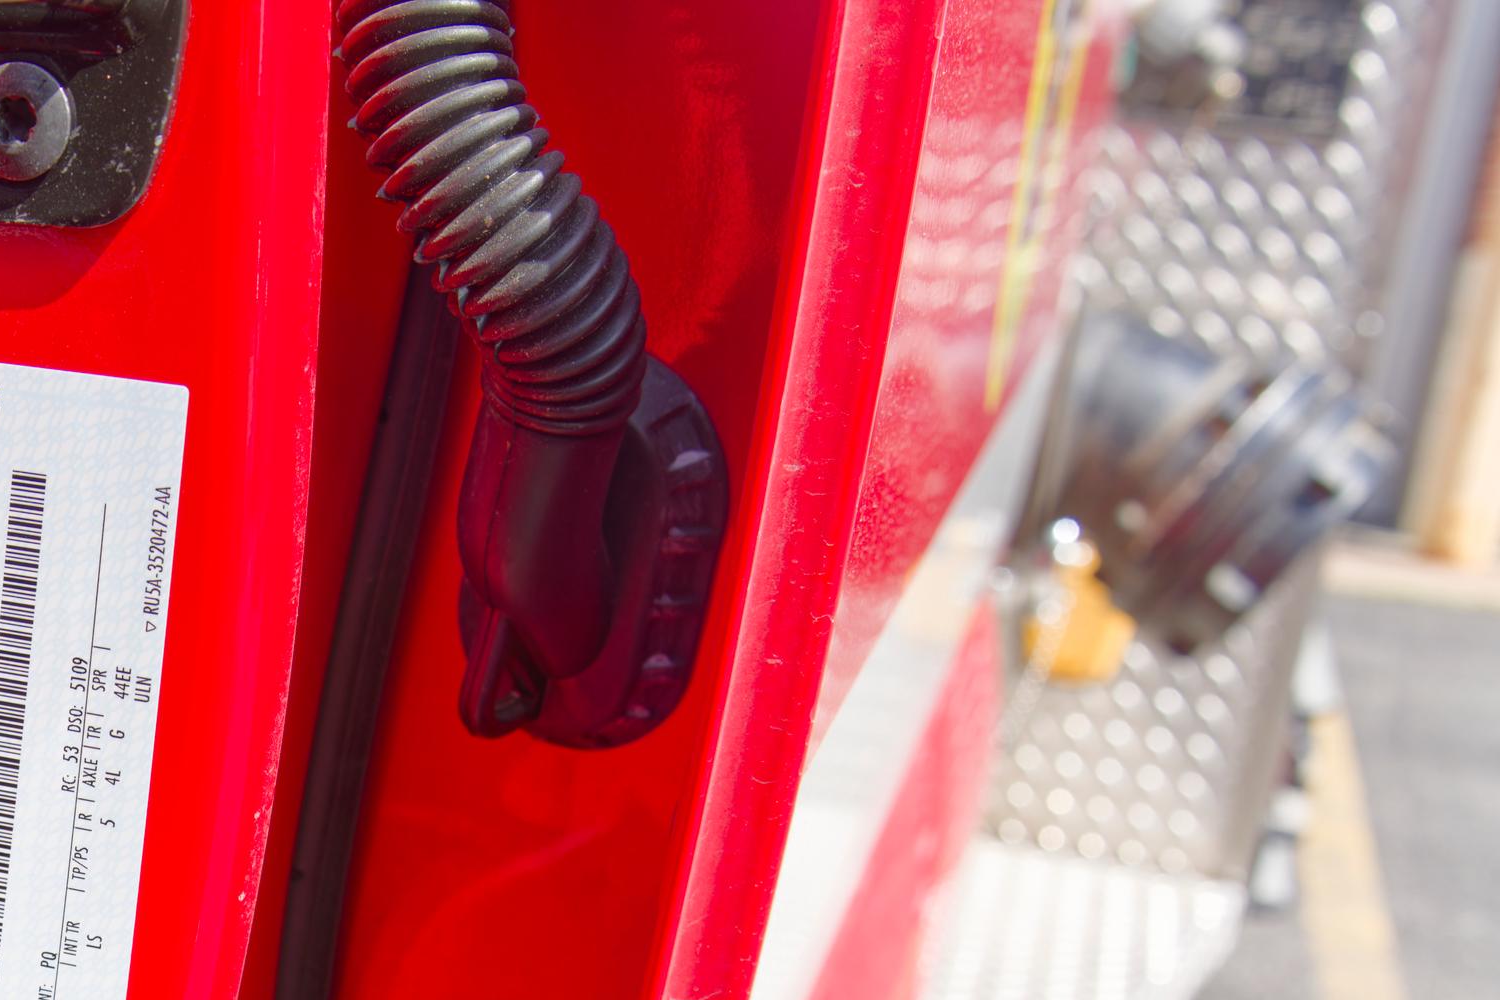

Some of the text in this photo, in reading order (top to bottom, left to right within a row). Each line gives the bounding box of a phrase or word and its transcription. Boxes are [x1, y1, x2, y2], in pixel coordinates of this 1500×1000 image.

[134, 487, 171, 703] ULN RU5A-3520472-AA
[70, 657, 88, 692] 5109
[91, 669, 107, 692] SPR
[114, 666, 132, 699] 44EE
[86, 725, 101, 739] TR
[109, 729, 125, 739] G
[63, 745, 79, 763] 53
[82, 758, 98, 788] AXLE
[104, 771, 121, 785] 4L
[61, 775, 76, 793] RC:
[78, 813, 92, 821] R
[100, 818, 115, 828] 5
[71, 846, 88, 880] TP/PS
[65, 921, 80, 933] TR
[63, 936, 78, 956] INT
[86, 935, 102, 949] LS
[40, 951, 57, 969] PQ
